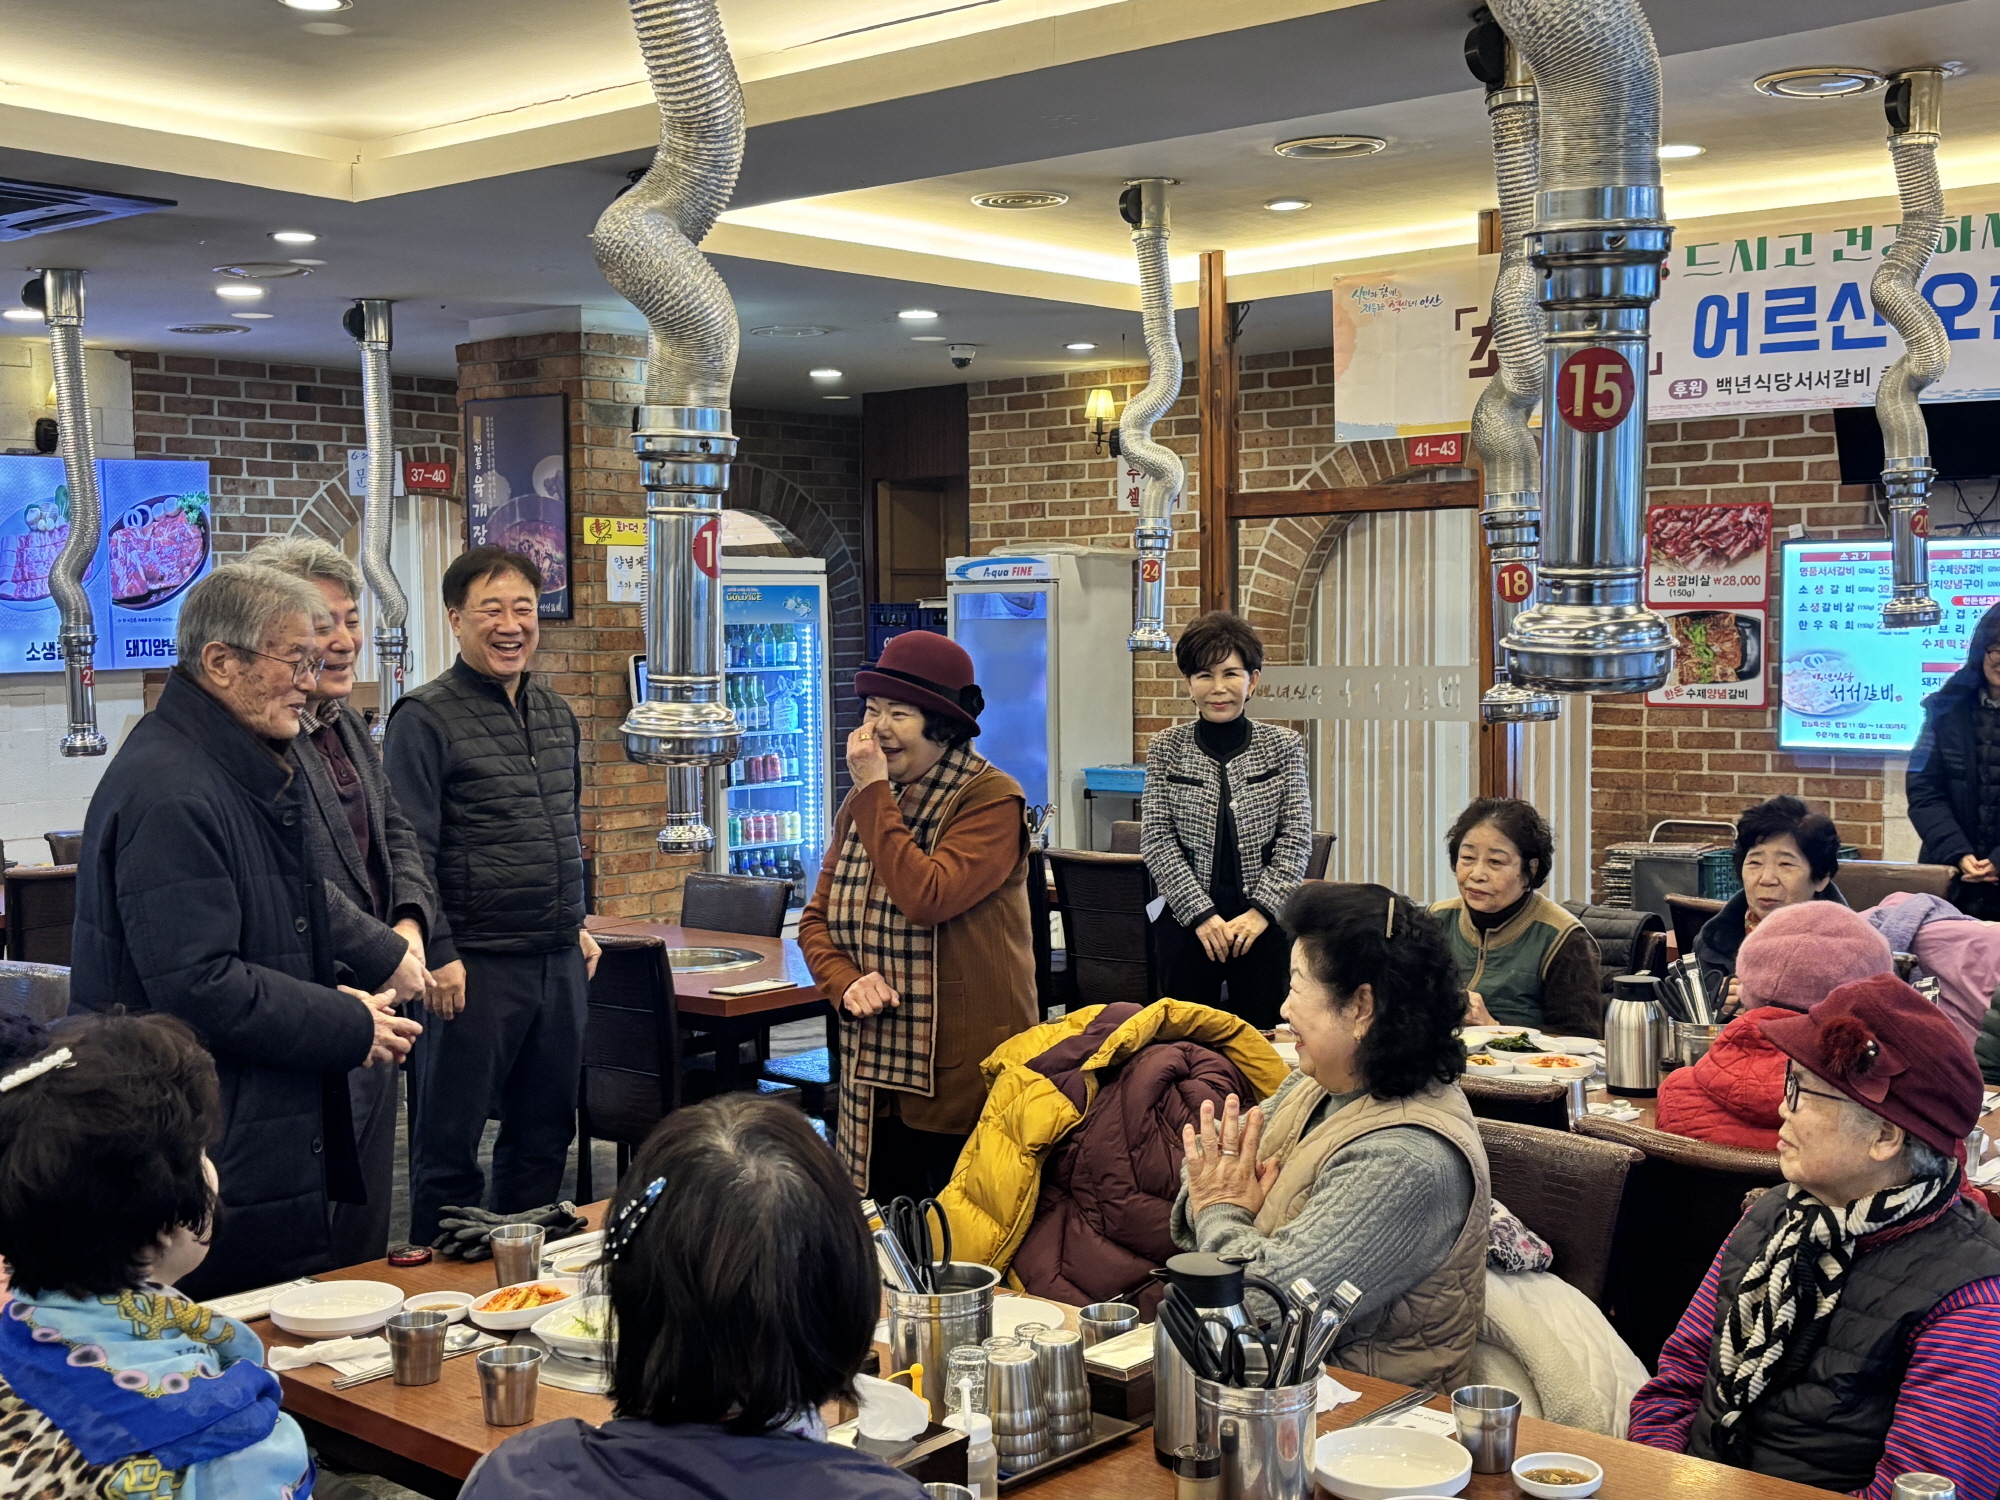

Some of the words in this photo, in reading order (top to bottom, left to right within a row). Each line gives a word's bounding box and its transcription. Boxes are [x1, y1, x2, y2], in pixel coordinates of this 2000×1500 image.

[1683, 232, 1816, 278] 드시고
[1833, 212, 2000, 263] 건하
[1419, 294, 1444, 308] 안산
[1693, 281, 1887, 359] 어르신
[1672, 380, 1703, 398] 후원
[1715, 366, 1871, 396] 백년식당서서갈비
[1567, 364, 1624, 419] 15
[473, 444, 483, 471] 전통
[1414, 440, 1457, 458] 41-43
[410, 467, 447, 483] 37-40
[472, 474, 489, 546] 육개장
[1839, 551, 1871, 561] 소고기
[982, 566, 1009, 579] Aqua
[1011, 566, 1033, 577] FINE
[1142, 563, 1160, 579] 24
[1500, 570, 1530, 597] 18
[1654, 574, 1711, 587] 소생갈비살
[1713, 575, 1761, 587] ₩28,000
[1669, 588, 1696, 598] (150g)
[1663, 685, 1685, 701] 한돈
[1685, 688, 1748, 700] 수제양념갈비
[1829, 682, 1894, 703] 서서갈비
